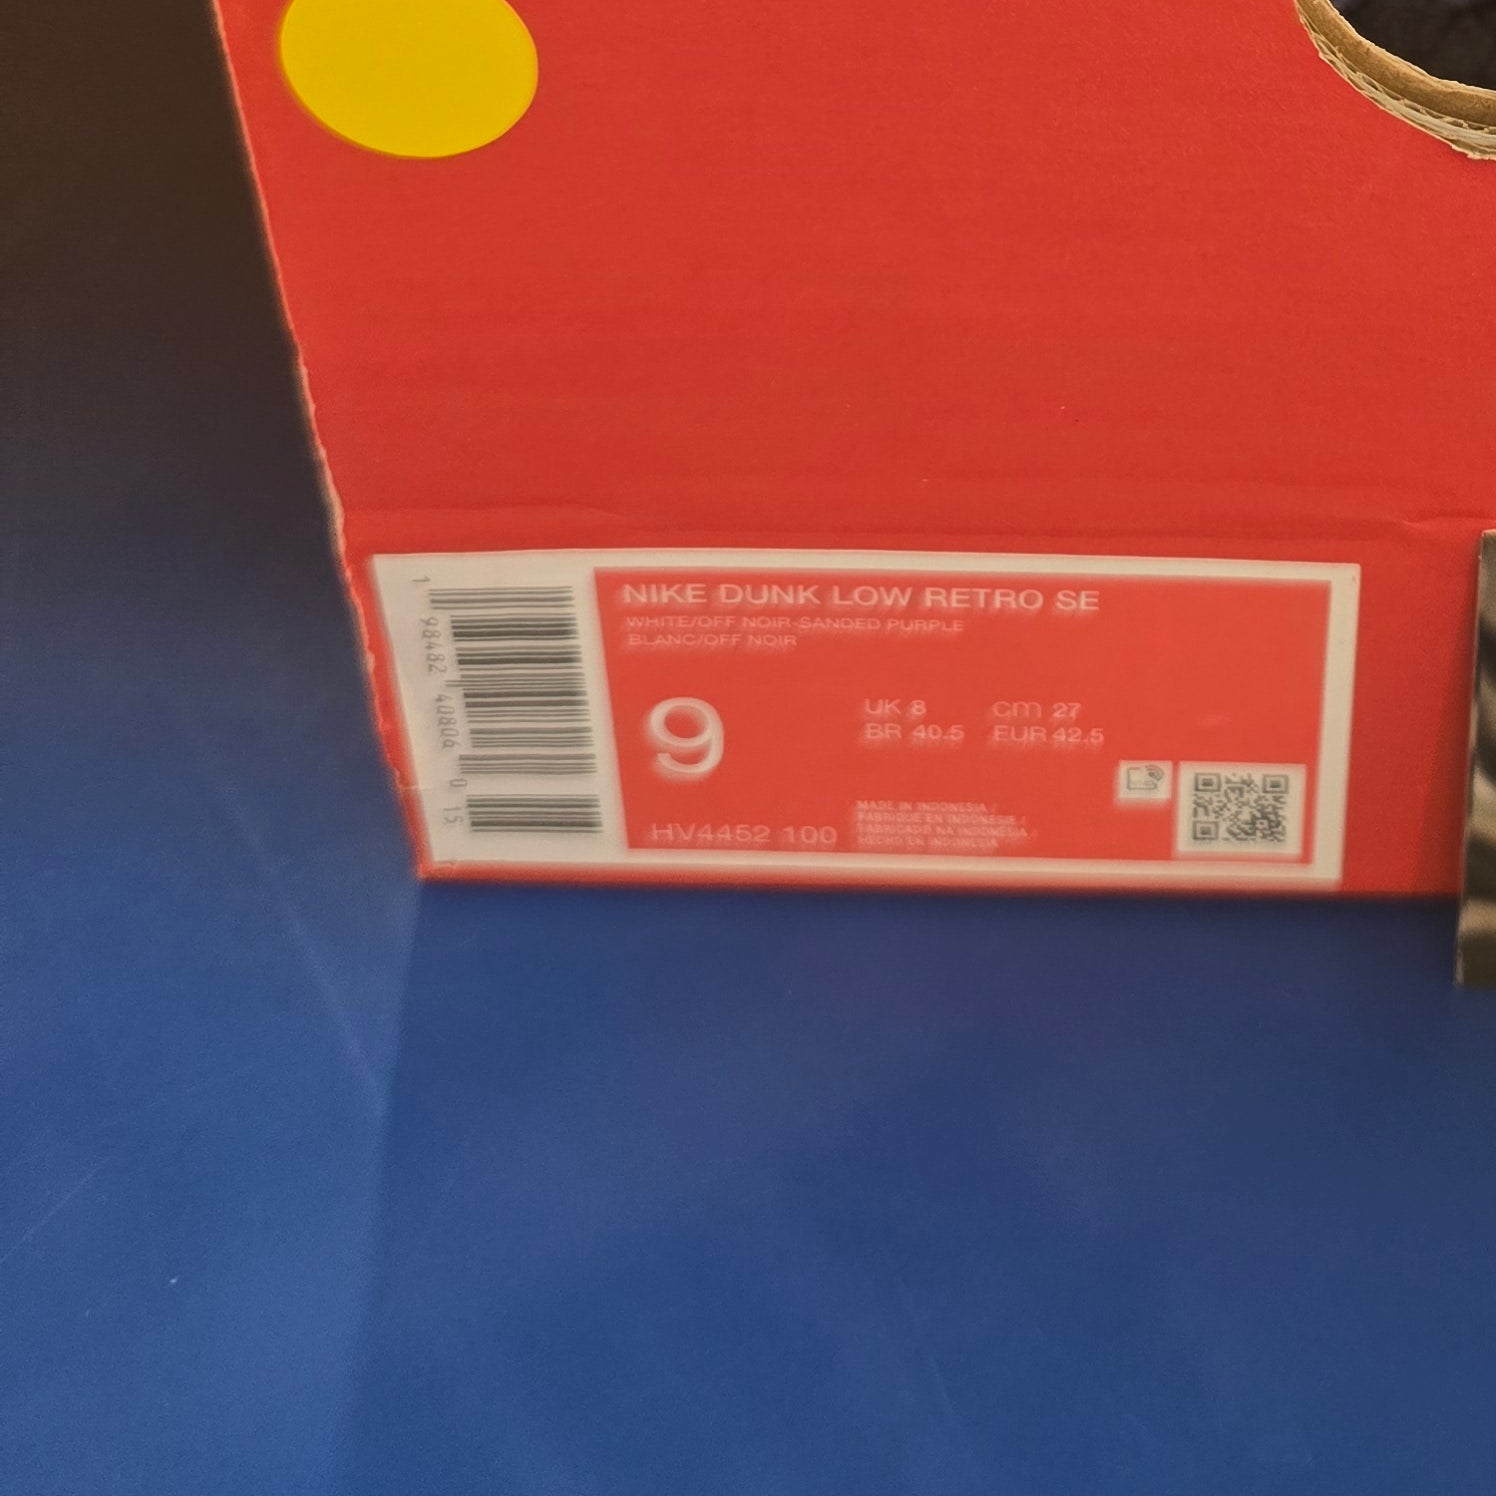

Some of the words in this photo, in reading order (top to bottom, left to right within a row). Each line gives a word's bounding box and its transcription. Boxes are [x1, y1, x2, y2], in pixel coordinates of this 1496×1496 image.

[412, 575, 431, 585] 1
[622, 583, 707, 605] NIKE
[719, 583, 821, 607] DUNK
[831, 585, 912, 608] LOW
[924, 587, 1044, 610] RETRO
[1055, 590, 1099, 611] SE
[625, 615, 736, 629] WHITE/OFF
[741, 616, 881, 631] NOIR-SANDED
[886, 618, 964, 632] PURPLE
[628, 633, 743, 647] BLANC/OFF
[747, 634, 798, 647] NOIR
[419, 616, 448, 674] 98482
[436, 694, 460, 750] 40806
[864, 699, 901, 716] UK
[911, 699, 927, 716] 8
[1052, 702, 1081, 719] 27
[648, 696, 725, 775] 9
[864, 723, 902, 740] BR
[912, 724, 965, 742] 40.5
[994, 725, 1047, 743] EUR
[1051, 727, 1104, 745] 42.5
[856, 799, 895, 810] MADE
[917, 801, 988, 813] INDONESIA
[651, 823, 770, 844] HV4452
[782, 825, 838, 845] 100
